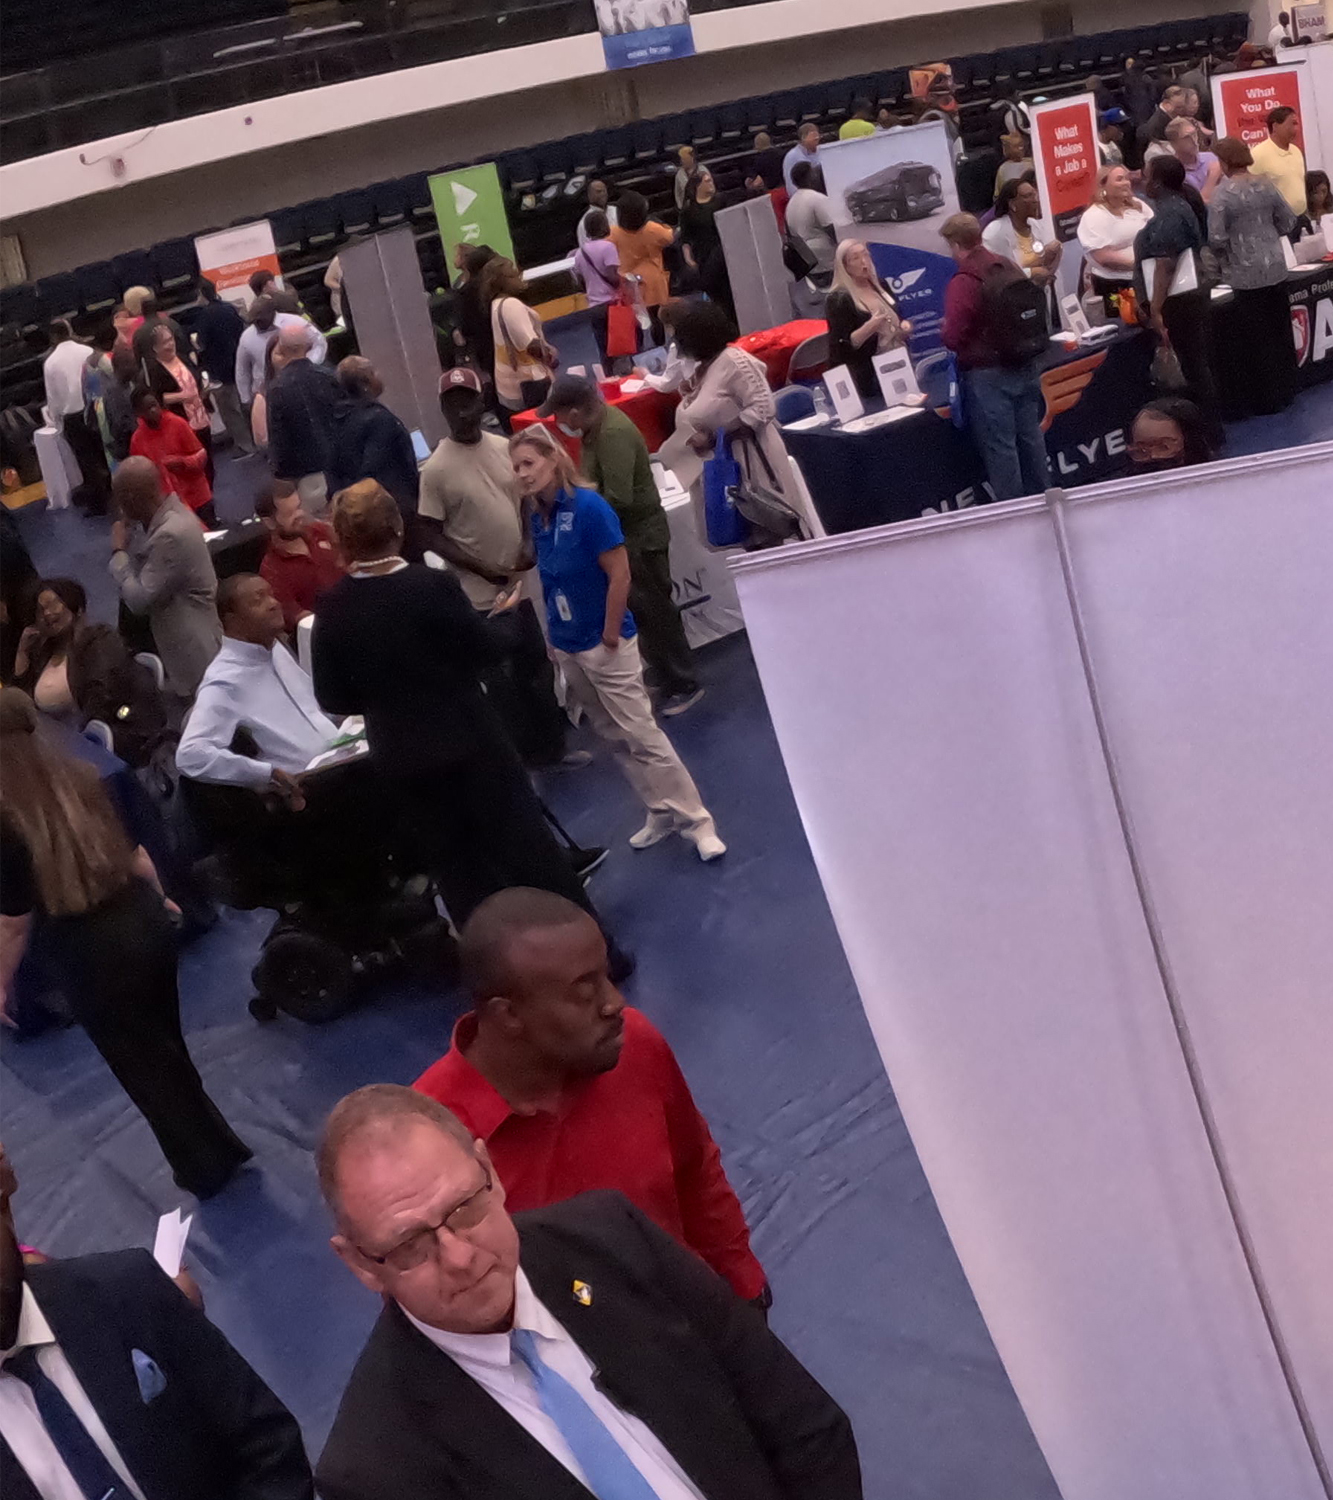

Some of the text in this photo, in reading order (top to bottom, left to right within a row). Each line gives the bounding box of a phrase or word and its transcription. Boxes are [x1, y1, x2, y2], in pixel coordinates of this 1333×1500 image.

[1246, 86, 1276, 99] What
[1240, 102, 1262, 113] You
[1054, 124, 1078, 140] What
[1241, 126, 1267, 140] Can'
[1053, 142, 1083, 159] Makes
[1063, 158, 1080, 174] Job
